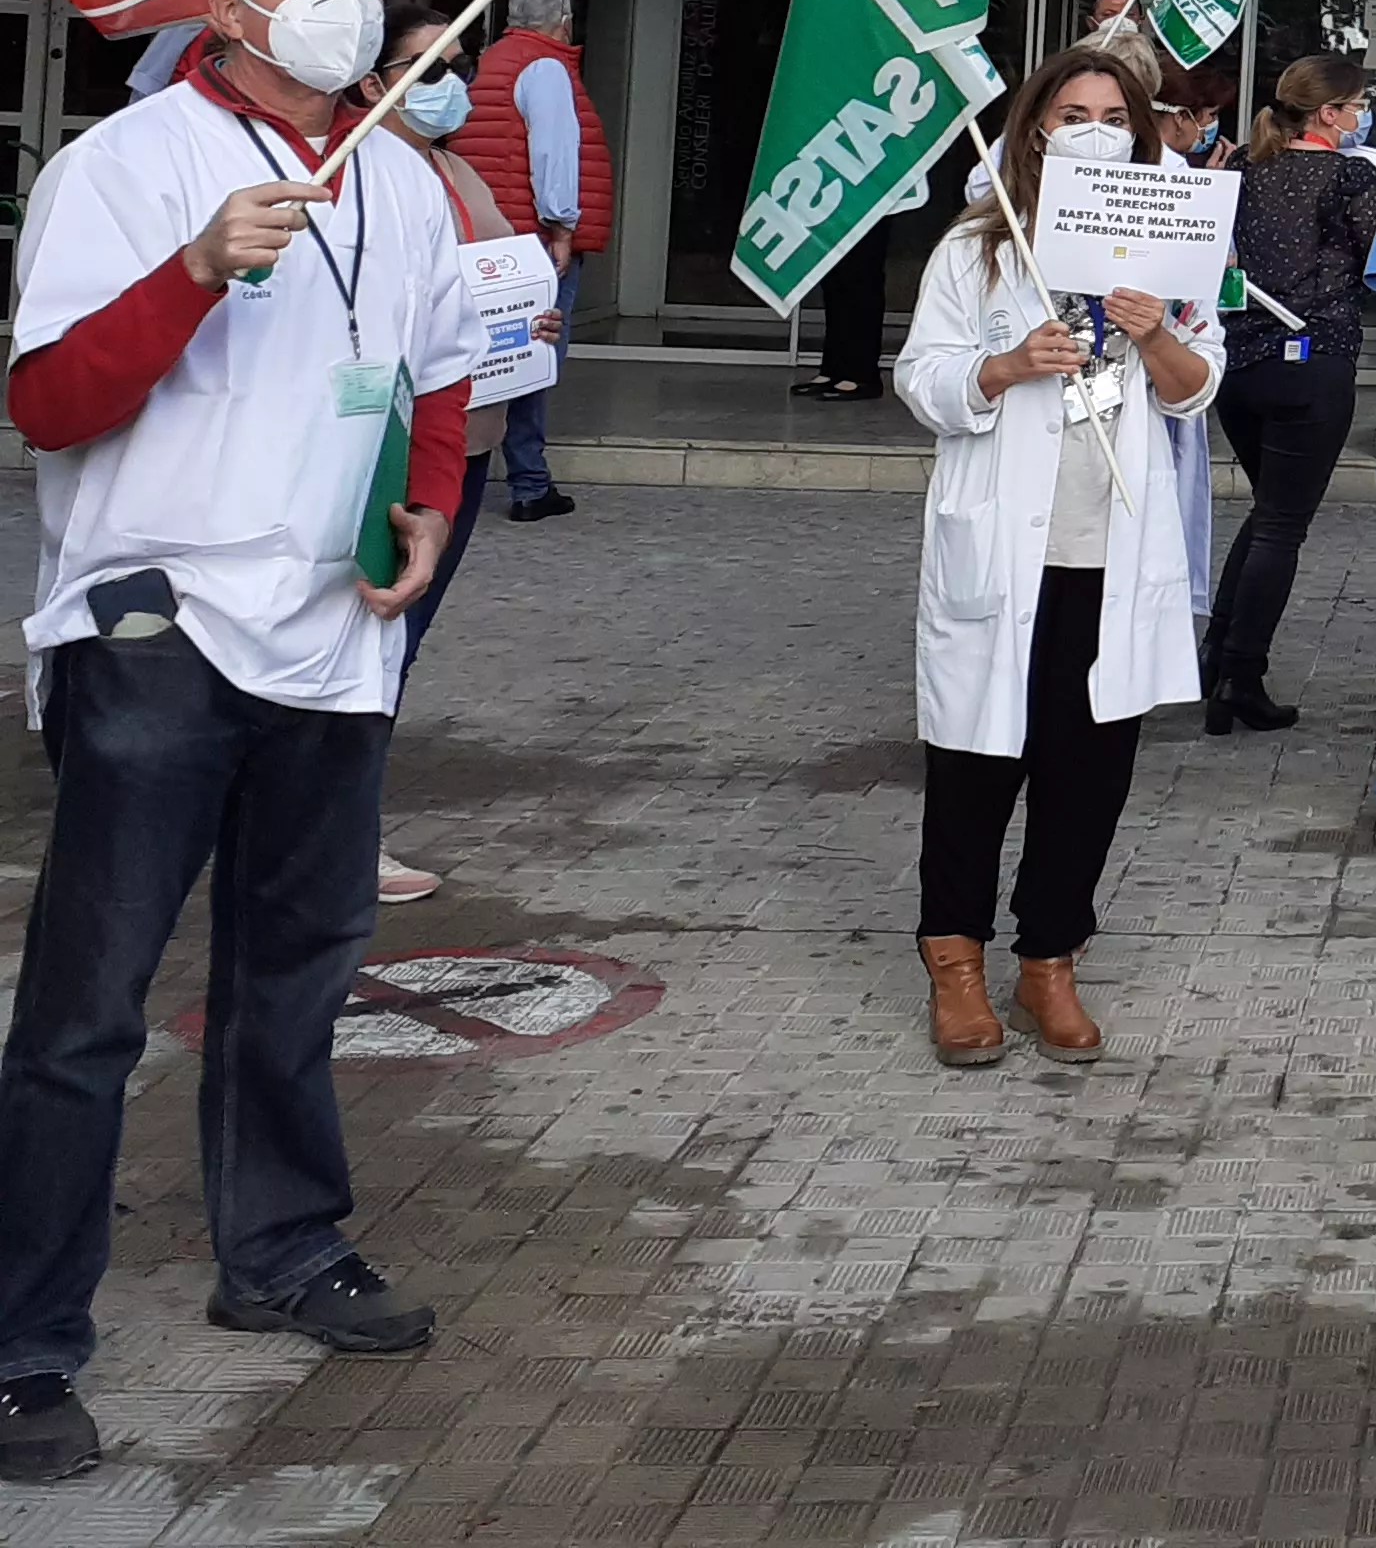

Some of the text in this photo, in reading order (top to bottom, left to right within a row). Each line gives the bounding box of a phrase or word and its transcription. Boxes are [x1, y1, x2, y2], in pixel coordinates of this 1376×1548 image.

[690, 94, 712, 190] CONSEJERI
[1074, 166, 1212, 186] POR NUESTRA SALUD
[1092, 183, 1192, 200] POR NUESTROS
[1105, 198, 1175, 212] DERECHOS
[1058, 208, 1216, 230] BASTA YA DE MALTRATO
[1054, 222, 1216, 242] AL PERSONAL SANITARIO
[506, 300, 535, 313] SALUD
[516, 351, 533, 361] SER
